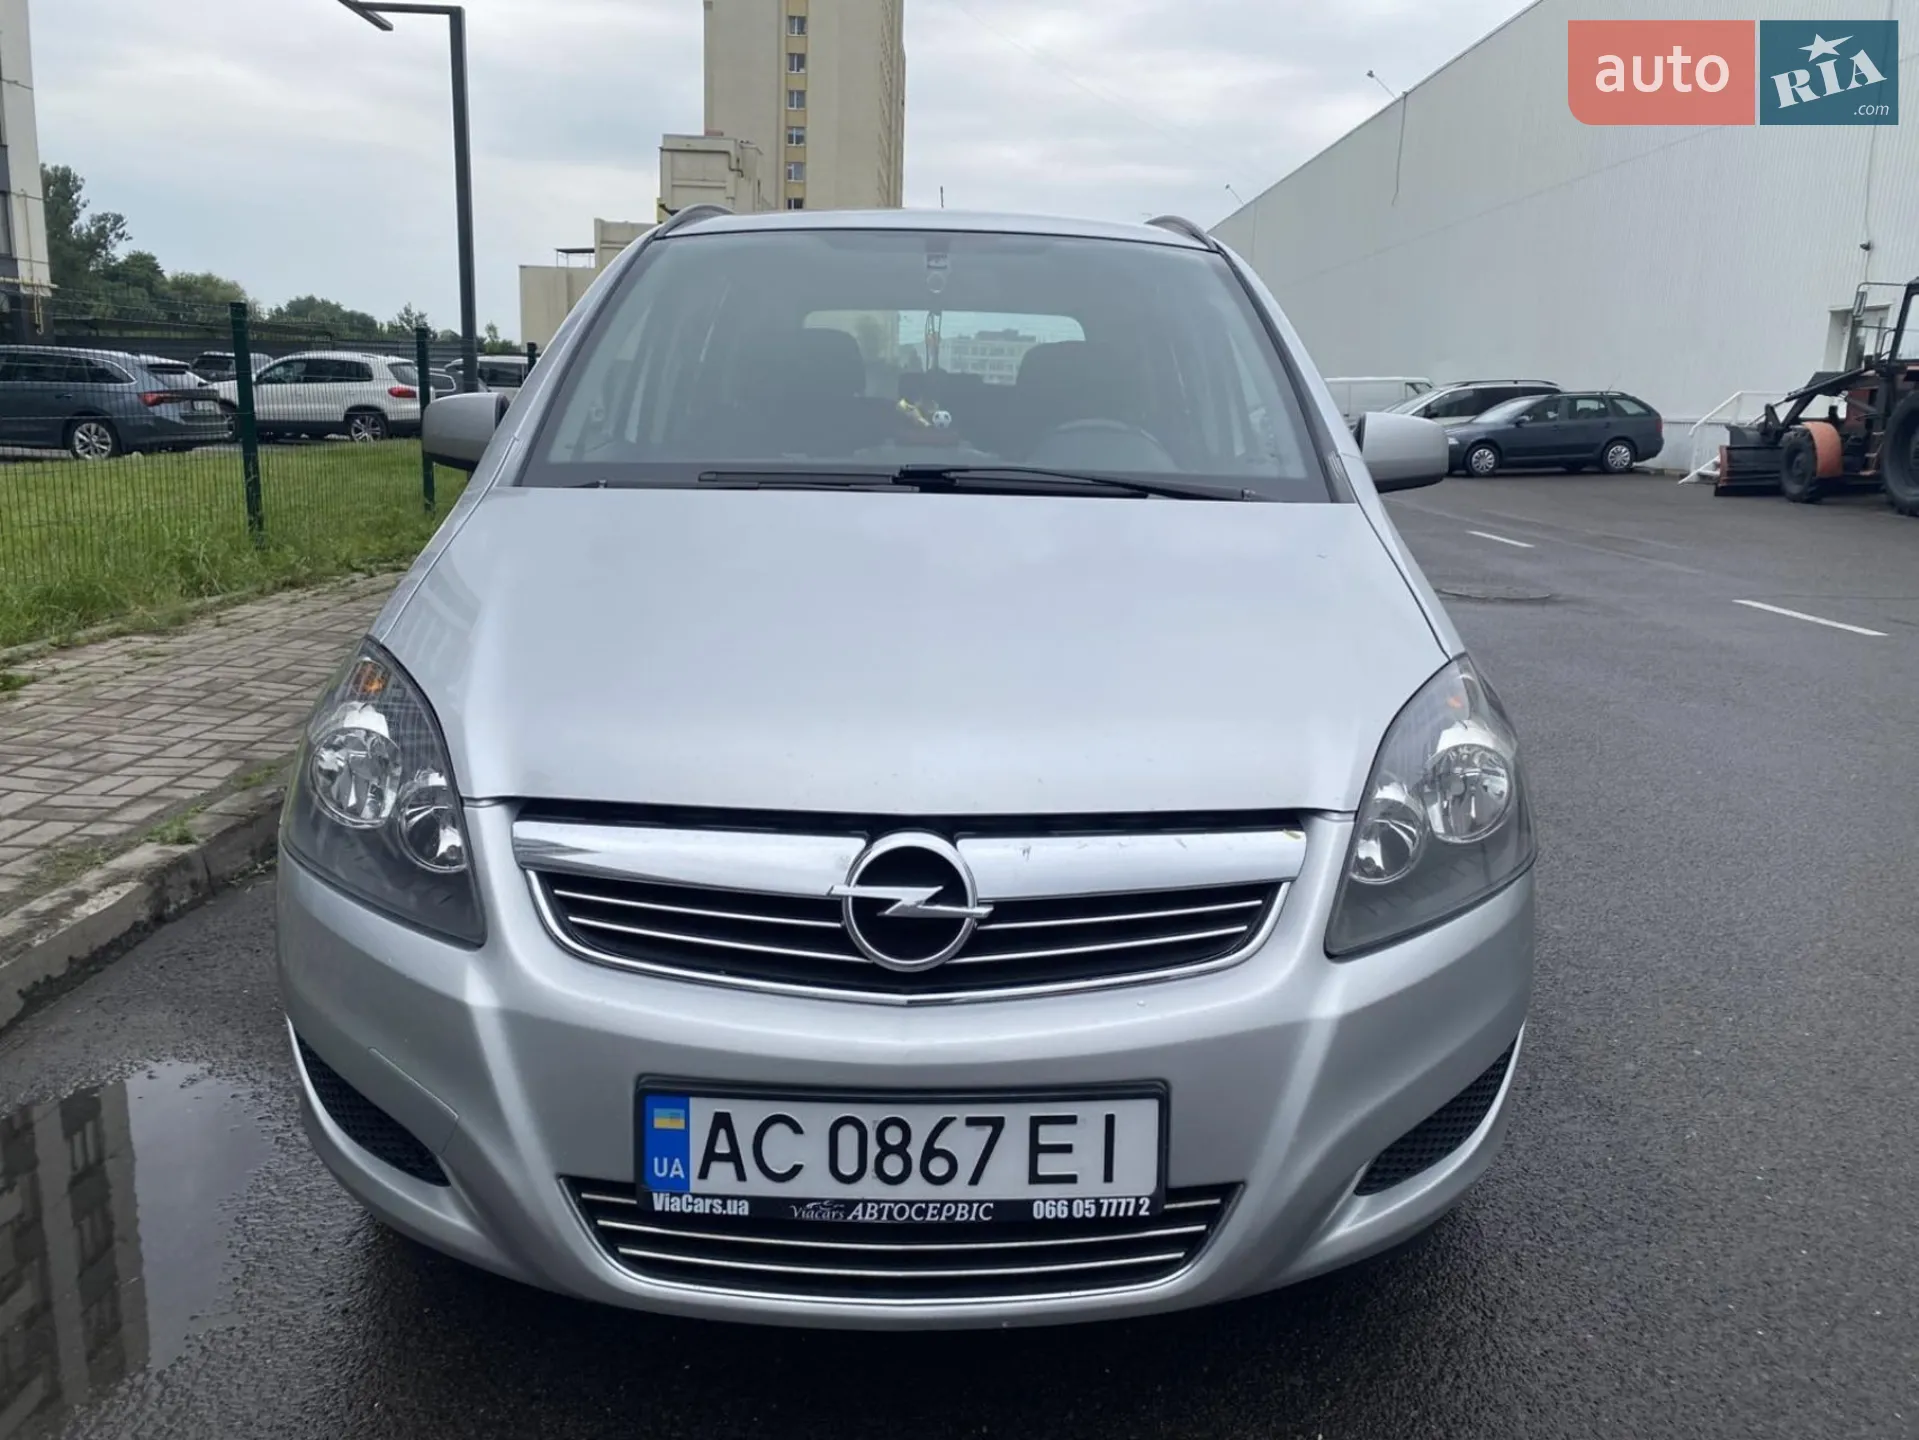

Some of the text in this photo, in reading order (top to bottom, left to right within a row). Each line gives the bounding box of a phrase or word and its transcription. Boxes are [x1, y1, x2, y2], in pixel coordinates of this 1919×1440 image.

[828, 1115, 1006, 1186] 0867
[653, 1157, 685, 1179] UA
[652, 1192, 749, 1216] ViaCars.ua
[1032, 1200, 1069, 1220] 066
[1072, 1199, 1096, 1218] 05
